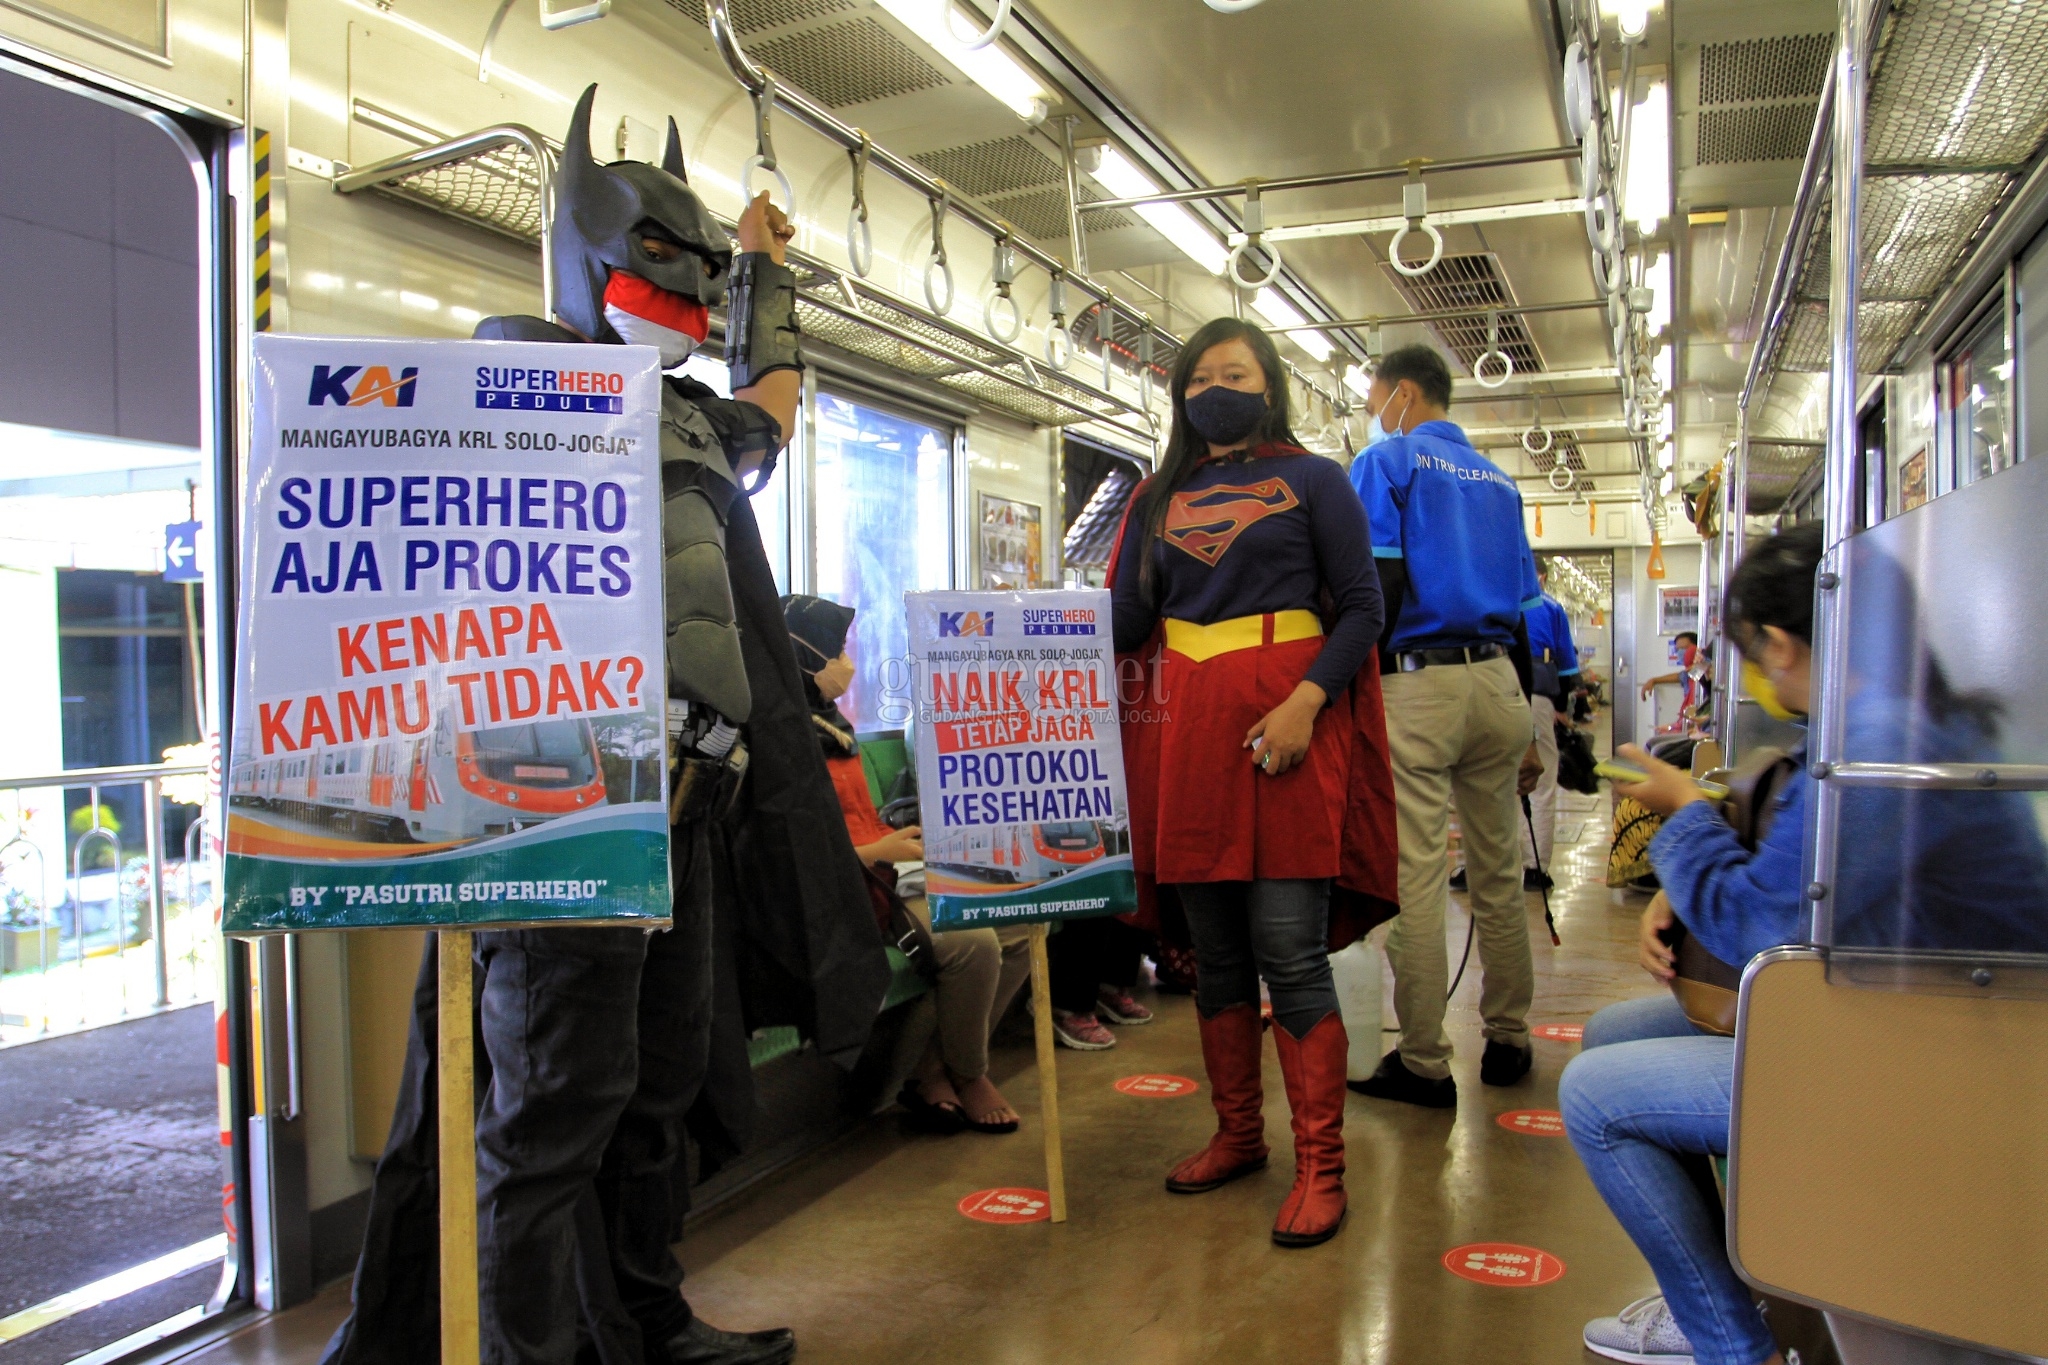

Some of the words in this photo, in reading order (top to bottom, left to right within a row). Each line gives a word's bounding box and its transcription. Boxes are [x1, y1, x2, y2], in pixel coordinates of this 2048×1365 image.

[308, 365, 418, 407] KAI
[476, 367, 624, 395] SUPERHERO
[486, 393, 613, 411] PEDULI
[281, 429, 450, 449] MANGAYUBAGYA
[459, 430, 498, 449] KRL
[278, 476, 627, 534] SUPERHERO
[271, 541, 383, 594] AJA
[405, 539, 632, 598] PROKES
[337, 602, 563, 678] KENAPA
[938, 611, 994, 638] KAI
[1023, 609, 1096, 623] SUPERHERO
[1028, 624, 1093, 635] PEDULI
[927, 649, 1014, 663] MANGAYUBAGYA
[1017, 649, 1036, 661] KRL
[258, 679, 431, 755] KAMU
[447, 656, 645, 727] TIDAK?
[932, 671, 1026, 714] NAIK
[1038, 669, 1110, 710] KRL
[951, 718, 1022, 750] TETAP
[1030, 714, 1095, 743] JAGA
[938, 748, 1109, 789] PROTOKOL
[943, 786, 1113, 827] KESEHATAN
[290, 886, 328, 906] BY
[334, 881, 452, 905] "PASUTRI
[962, 908, 980, 921] BY
[983, 902, 1038, 919] "PASUTRI
